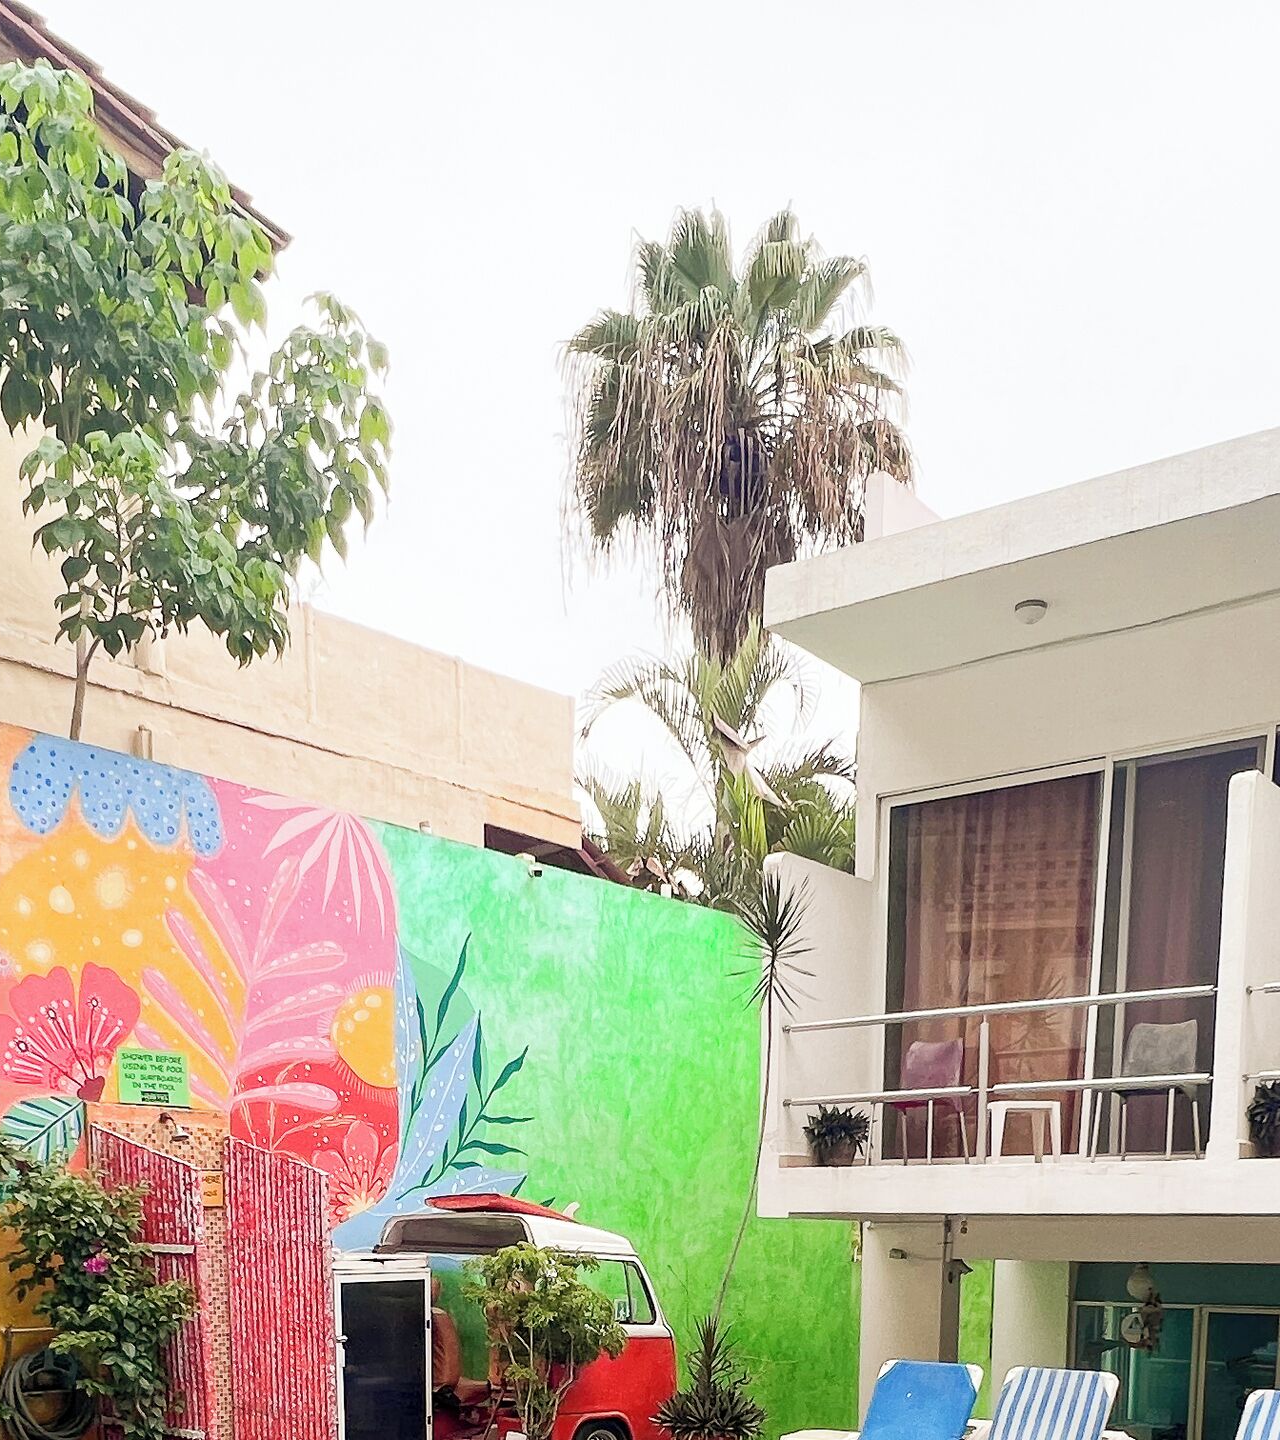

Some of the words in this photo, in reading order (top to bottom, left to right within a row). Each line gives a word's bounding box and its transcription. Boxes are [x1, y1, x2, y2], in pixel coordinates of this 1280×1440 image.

[122, 1053, 153, 1062] SHOWER
[155, 1055, 182, 1064] BEFORE
[150, 1064, 164, 1072] THE
[140, 1074, 182, 1083] SURFBOARDS
